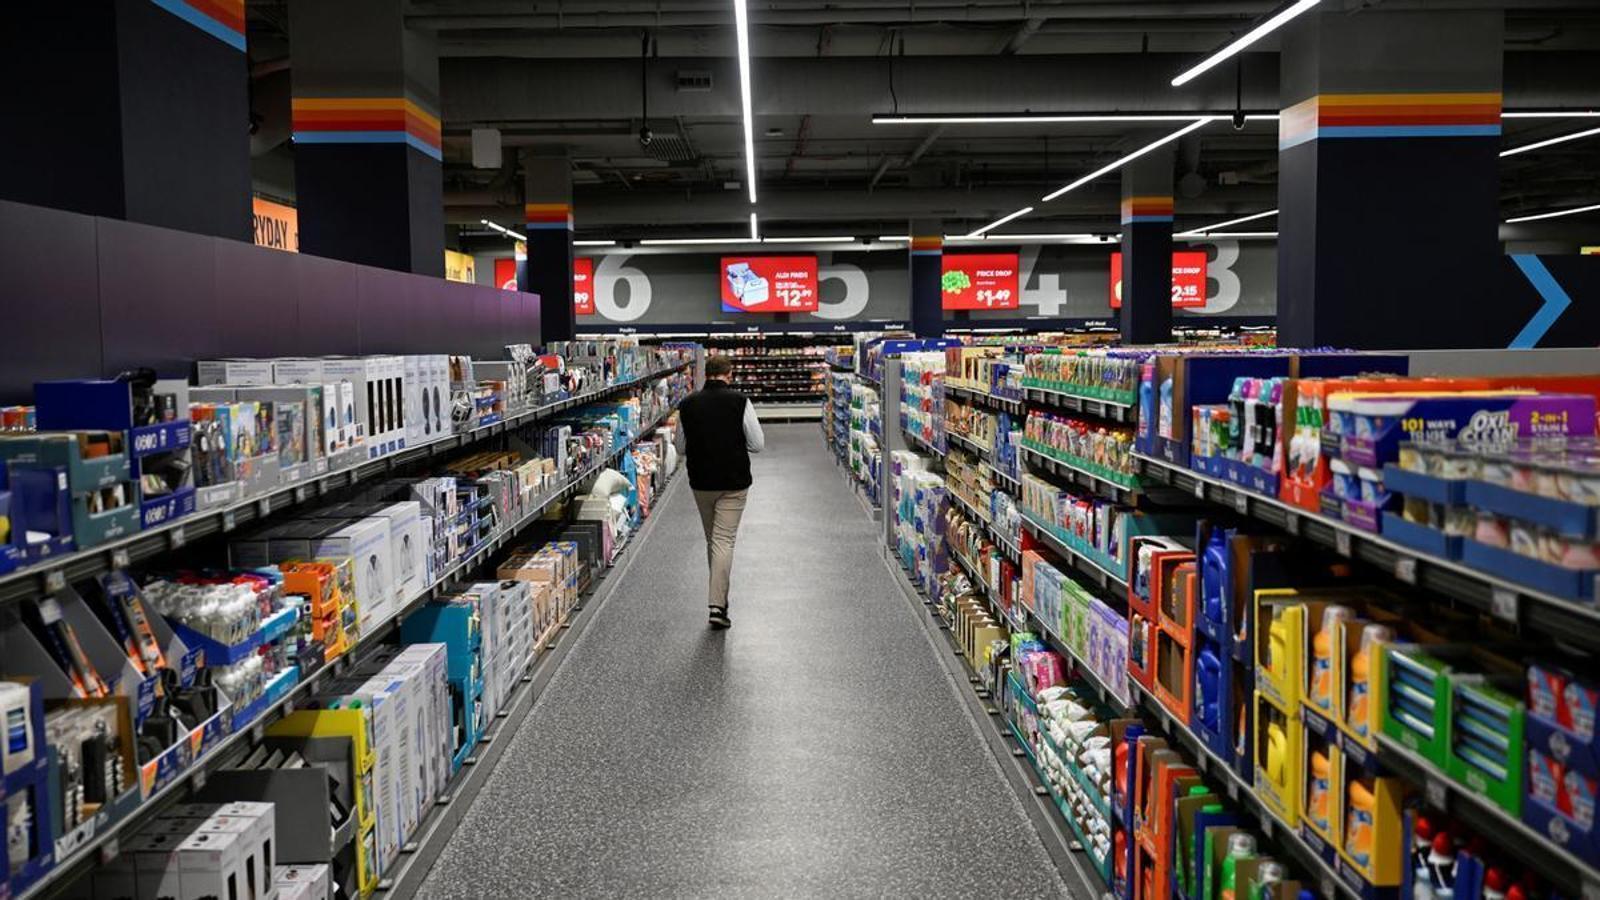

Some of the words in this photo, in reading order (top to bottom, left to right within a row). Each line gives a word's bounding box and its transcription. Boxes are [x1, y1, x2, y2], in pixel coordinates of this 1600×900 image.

[593, 254, 652, 322] 6
[810, 251, 869, 319] 5
[1018, 244, 1067, 316] 4
[1184, 240, 1241, 314] 3
[1402, 418, 1424, 432] 101
[1427, 419, 1456, 430] WAYS
